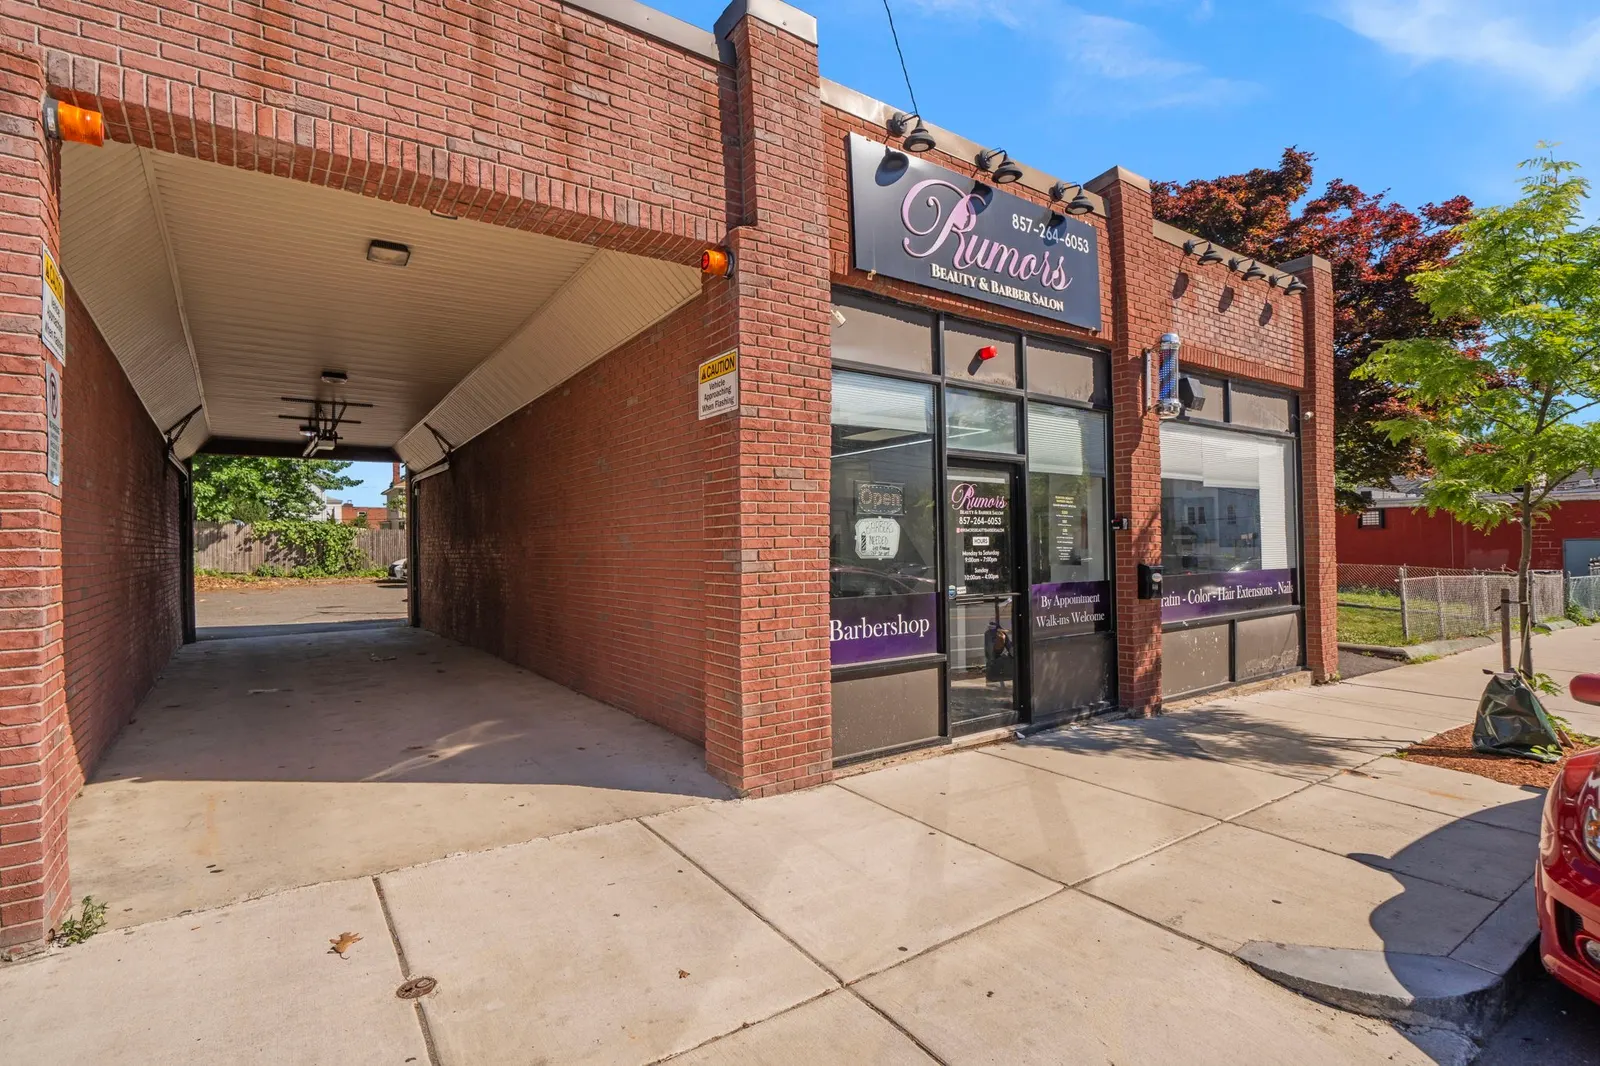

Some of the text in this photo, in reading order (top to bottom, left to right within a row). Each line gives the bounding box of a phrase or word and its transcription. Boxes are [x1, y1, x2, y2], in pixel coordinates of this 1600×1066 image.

[901, 178, 1073, 291] Rumors
[1012, 213, 1090, 254] 857-264-6053
[930, 263, 1065, 312] BEAUTY & BARBER SALON
[706, 356, 735, 378] CAUTION
[704, 385, 732, 402] Approaching
[708, 379, 726, 390] Vehicle
[702, 395, 735, 413] When Flashing
[860, 487, 901, 509] Open
[951, 482, 1008, 511] Rumors
[959, 516, 1002, 525] 857-264-6053
[1041, 593, 1101, 609] By Appointment
[1187, 588, 1211, 605] Color
[1217, 585, 1236, 601] Hair
[1236, 583, 1273, 599] Extensions
[1277, 580, 1294, 595] Nails
[829, 613, 930, 642] Barbershop
[1036, 610, 1106, 628] Walk-ins Welcome
